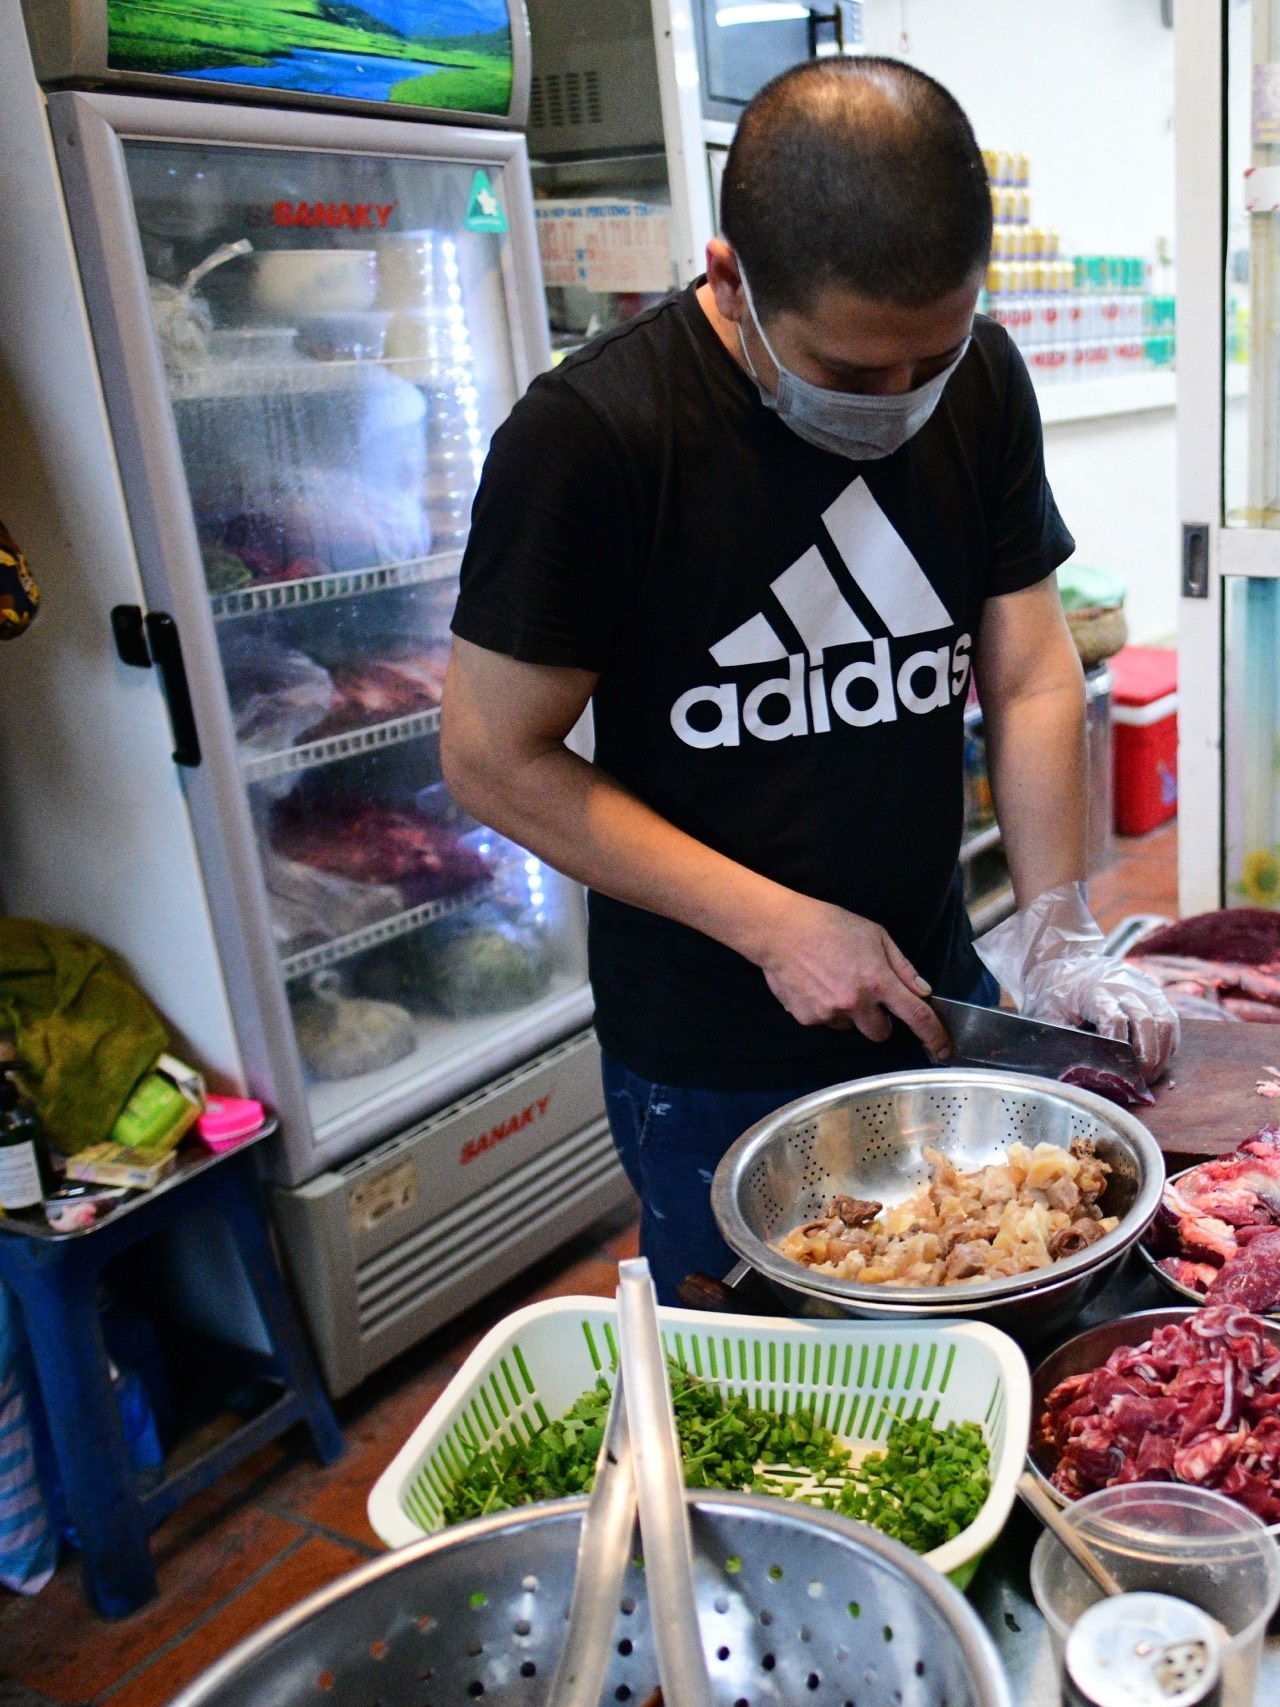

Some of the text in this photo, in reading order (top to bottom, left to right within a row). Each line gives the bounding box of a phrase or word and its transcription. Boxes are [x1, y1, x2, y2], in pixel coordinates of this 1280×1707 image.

[273, 200, 393, 228] SANAKY
[669, 633, 971, 749] adidas
[459, 1094, 549, 1166] SANAKY
